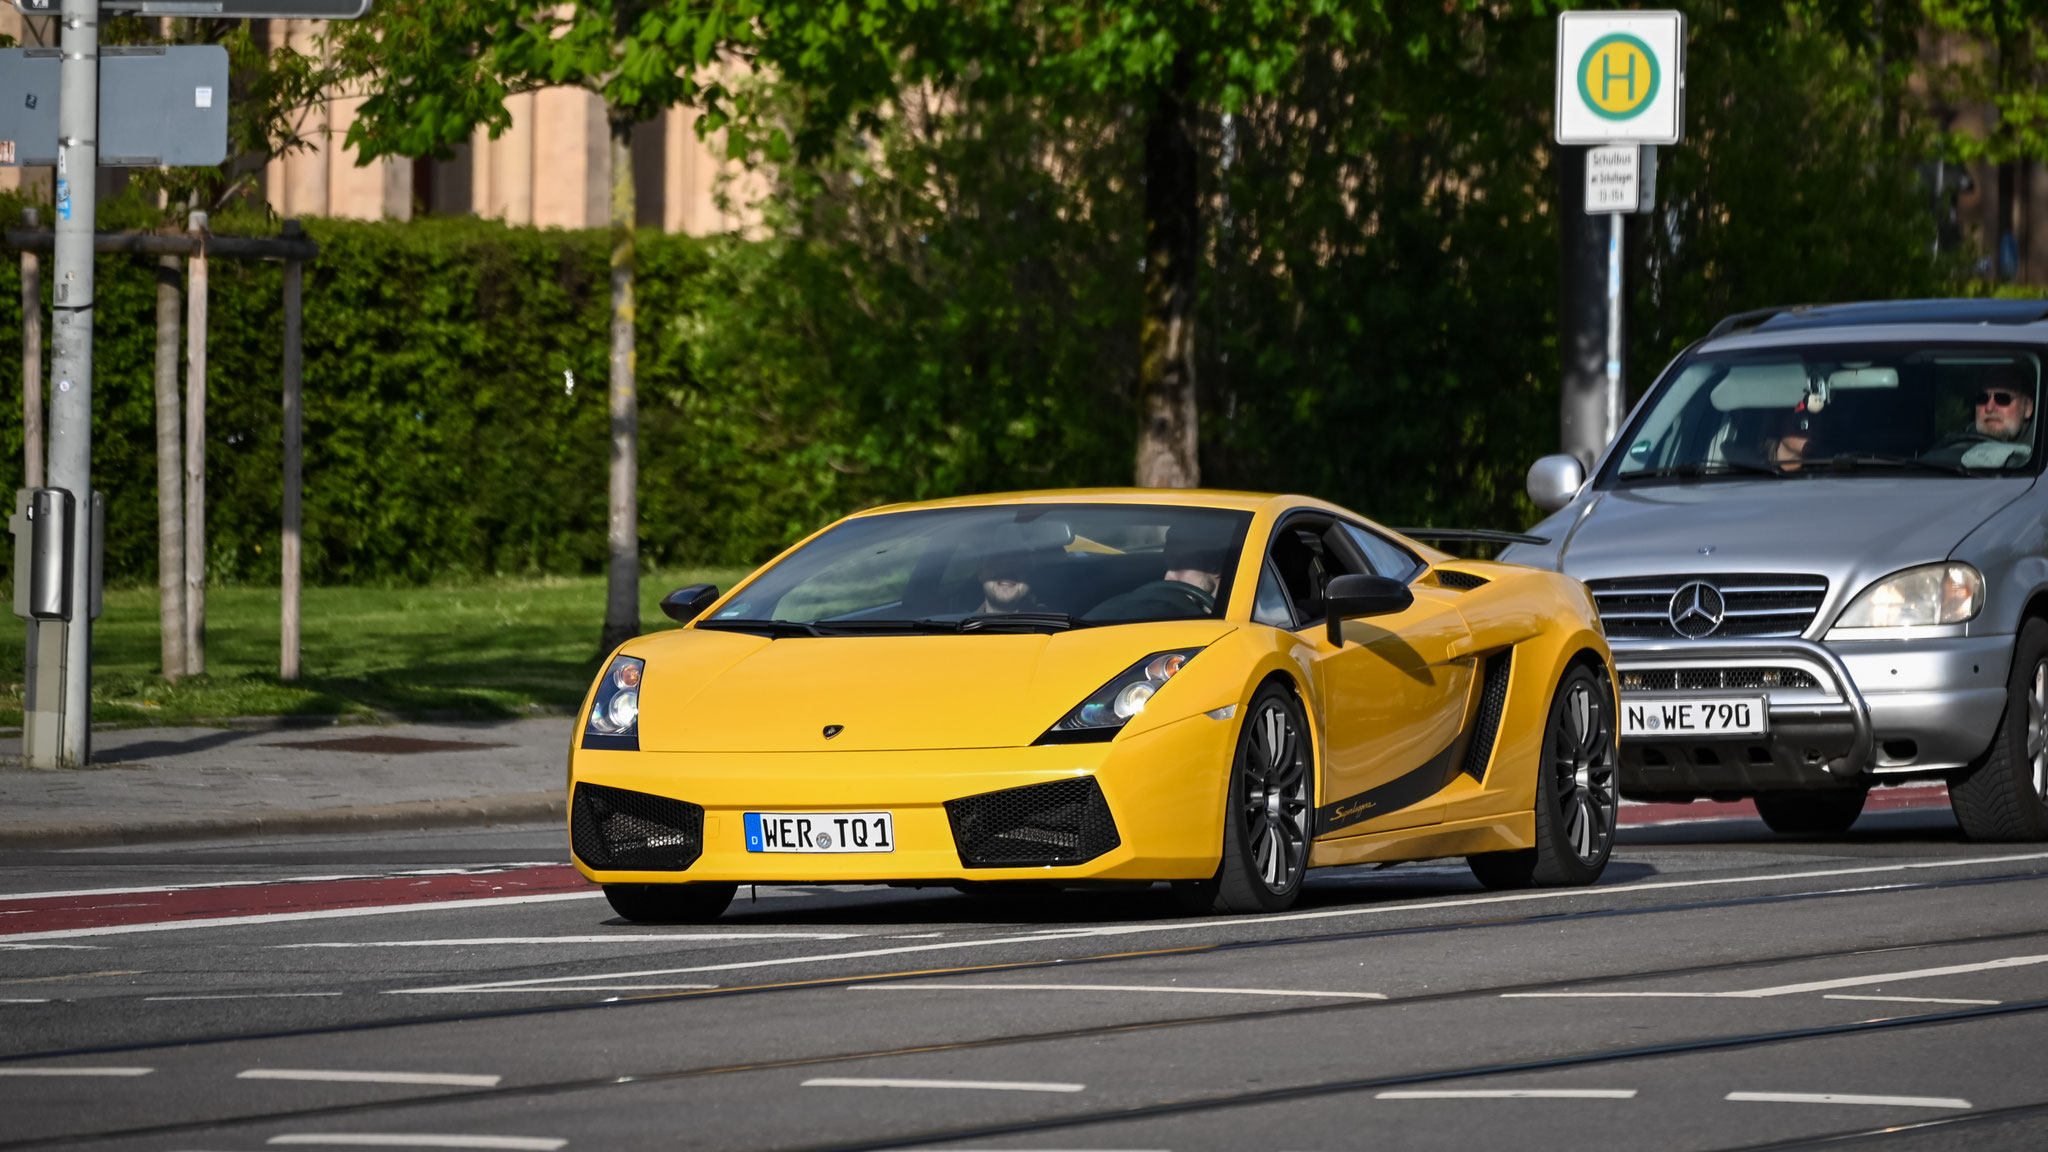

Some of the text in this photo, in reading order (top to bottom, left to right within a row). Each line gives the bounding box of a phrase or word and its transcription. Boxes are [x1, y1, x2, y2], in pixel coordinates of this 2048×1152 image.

[1602, 52, 1636, 102] H
[1593, 152, 1632, 167] Schulbus
[1628, 704, 1751, 730] N WE 790
[751, 818, 889, 848] D WER TQ1
